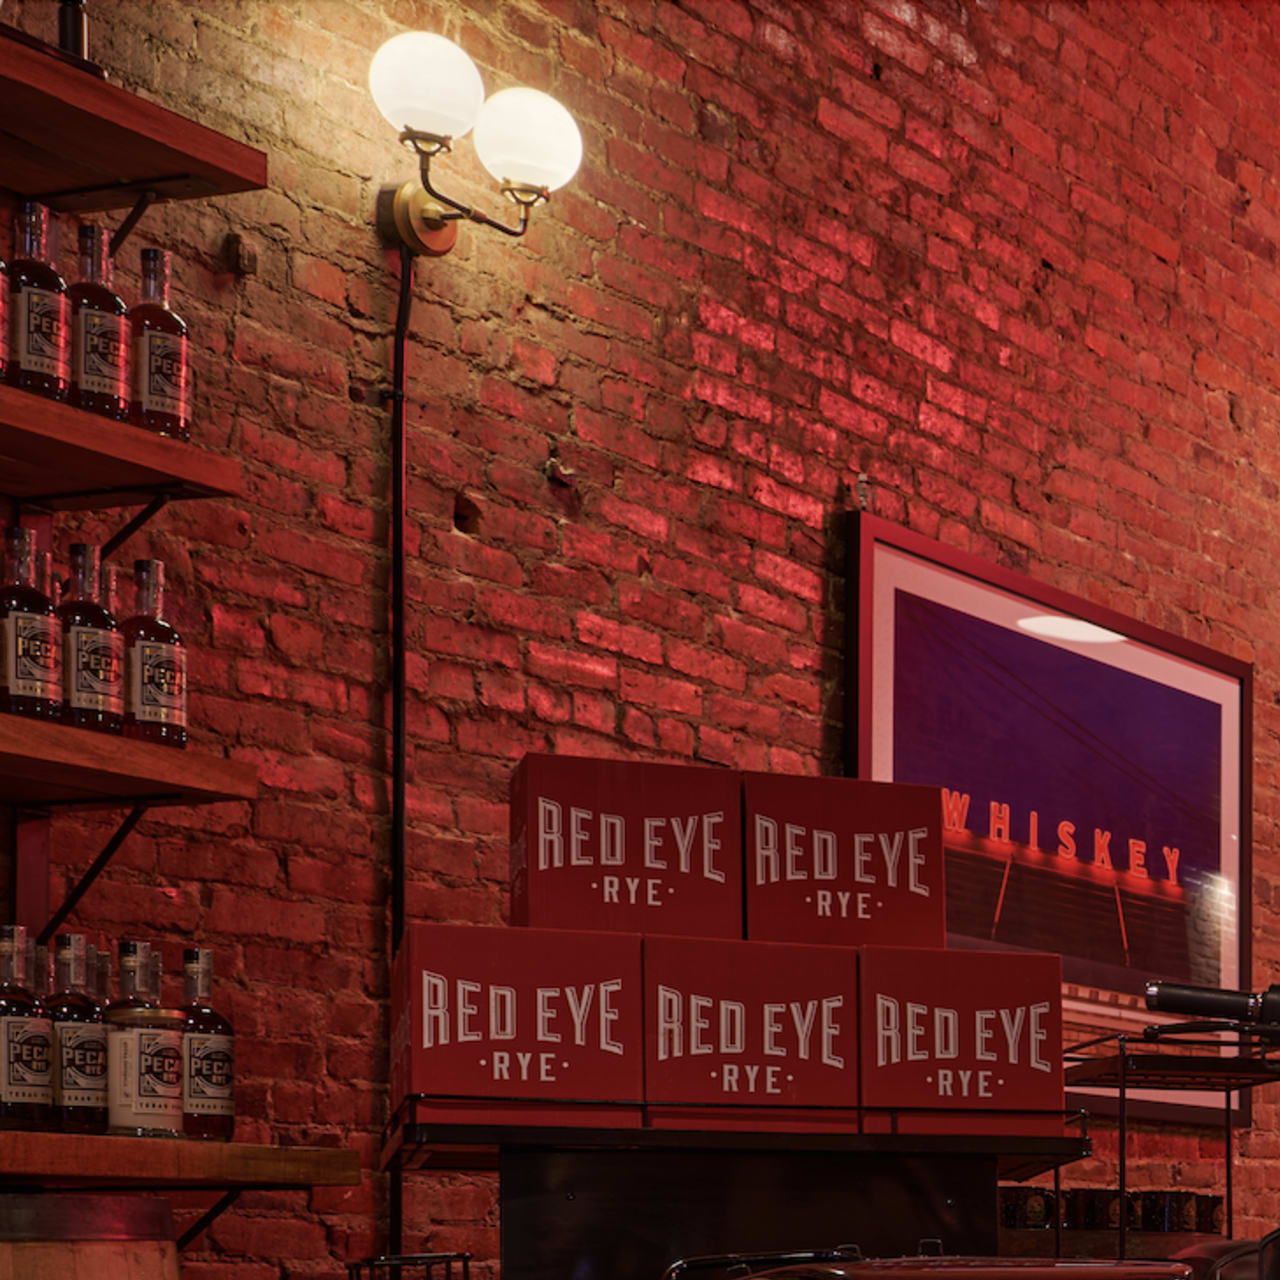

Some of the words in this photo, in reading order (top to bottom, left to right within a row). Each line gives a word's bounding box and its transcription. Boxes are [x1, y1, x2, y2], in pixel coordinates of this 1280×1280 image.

[538, 796, 626, 871] RED
[643, 811, 726, 883] EYE
[754, 813, 837, 885] RED
[854, 827, 930, 897] EYE
[941, 788, 1180, 886] WHISKEY
[603, 876, 663, 906] RYE
[816, 889, 873, 920] RYE
[422, 969, 518, 1049] RED
[536, 978, 624, 1055] EYE
[657, 984, 746, 1061] RED
[763, 995, 844, 1069] EYE
[876, 993, 960, 1067] RED
[975, 1001, 1052, 1073] EYE
[493, 1051, 557, 1083] RYE
[722, 1064, 782, 1094] RYE
[936, 1069, 993, 1098] RYE
